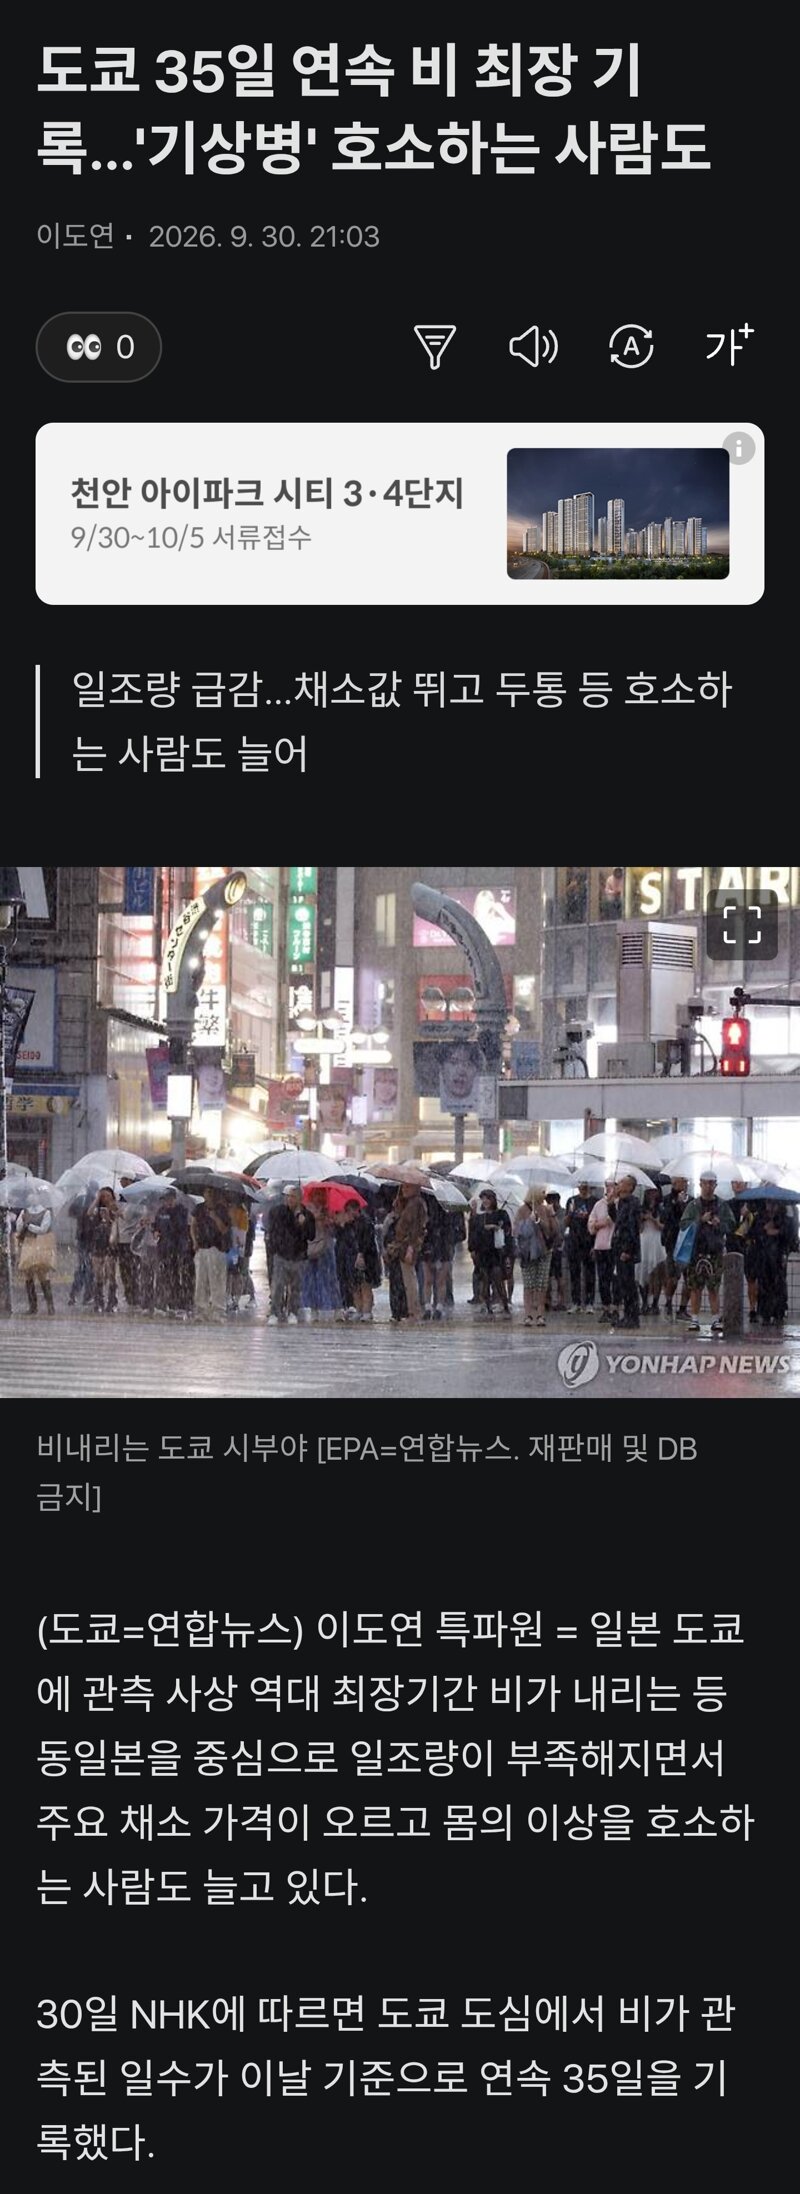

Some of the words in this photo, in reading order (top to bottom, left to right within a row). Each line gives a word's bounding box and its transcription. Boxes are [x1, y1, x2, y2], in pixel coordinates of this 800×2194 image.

[38, 47, 140, 91] 도쿄
[155, 43, 274, 97] 35일
[293, 43, 395, 97] 연속
[413, 43, 455, 97] 비
[475, 43, 578, 97] 최장
[593, 43, 638, 97] 기
[332, 120, 540, 175] 호소하는
[555, 121, 711, 175] 사람도
[38, 222, 113, 249] 이도연
[150, 225, 221, 247] 2026.
[231, 226, 252, 247] 9.
[262, 226, 301, 247] 30.
[311, 225, 379, 247] 21:03
[117, 334, 134, 359] 0
[71, 477, 132, 509] 천안
[141, 477, 264, 509] 아이파크
[274, 477, 332, 509] 시티
[71, 524, 204, 552] 9/30~10/5
[213, 525, 311, 550] 서류접수
[74, 671, 180, 708] 일조량
[413, 671, 483, 708] 뛰고
[496, 672, 566, 708] 두통
[579, 672, 612, 708] 등
[625, 671, 732, 708] 호소하
[73, 737, 106, 771] 는
[119, 735, 225, 772] 사람도
[238, 735, 305, 772] 늘어
[640, 867, 790, 914] STAR
[38, 1433, 149, 1462] 비내리는
[159, 1436, 213, 1459] 도쿄
[224, 1433, 307, 1462] 시부야
[318, 1433, 518, 1464] [EPA=연합뉴스.
[529, 1434, 611, 1462] 재판매
[624, 1434, 647, 1462] 및
[659, 1437, 697, 1460] DB
[37, 1482, 100, 1513] 금지]
[39, 1610, 302, 1650] (도쿄=연합뉴스)
[318, 1611, 422, 1648] 이도연
[436, 1611, 541, 1648] 특파원
[557, 1627, 577, 1638] =
[591, 1611, 661, 1647] 일본
[673, 1614, 744, 1643] 도쿄
[38, 1675, 69, 1712] 에
[83, 1675, 154, 1712] 관측
[167, 1675, 238, 1712] 사상
[250, 1675, 318, 1712] 역대
[333, 1675, 477, 1712] 최장기간
[492, 1675, 561, 1712] 비가
[575, 1675, 680, 1712] 내리는
[693, 1677, 727, 1712] 등
[37, 1739, 181, 1777] 동일본을
[194, 1739, 338, 1776] 중심으로
[351, 1739, 491, 1777] 일조량이
[507, 1739, 722, 1777] 부족해지면서
[37, 1806, 108, 1841] 주요
[120, 1804, 191, 1841] 채소
[204, 1804, 308, 1841] 가격이
[323, 1806, 430, 1836] 오르고
[443, 1804, 511, 1841] 몸의
[528, 1804, 634, 1841] 이상을
[647, 1804, 755, 1841] 호소하
[37, 1870, 71, 1904] 는
[83, 1868, 191, 1906] 사람도
[204, 1869, 274, 1905] 늘고
[287, 1868, 366, 1906] 있다.
[37, 1995, 117, 2032] 30일
[132, 1995, 244, 2032] NHK에
[259, 1995, 363, 2032] 따르면
[378, 1998, 449, 2027] 도쿄
[461, 1995, 602, 2032] 도심에서
[620, 1995, 689, 2032] 비가
[701, 1995, 735, 2031] 관
[37, 2059, 106, 2097] 측된
[121, 2059, 228, 2097] 일수가
[242, 2059, 311, 2097] 이날
[324, 2060, 467, 2097] 기준으로
[481, 2060, 551, 2097] 연속
[563, 2059, 681, 2096] 35일을
[694, 2060, 724, 2097] 기
[37, 2124, 154, 2161] 록했다.
